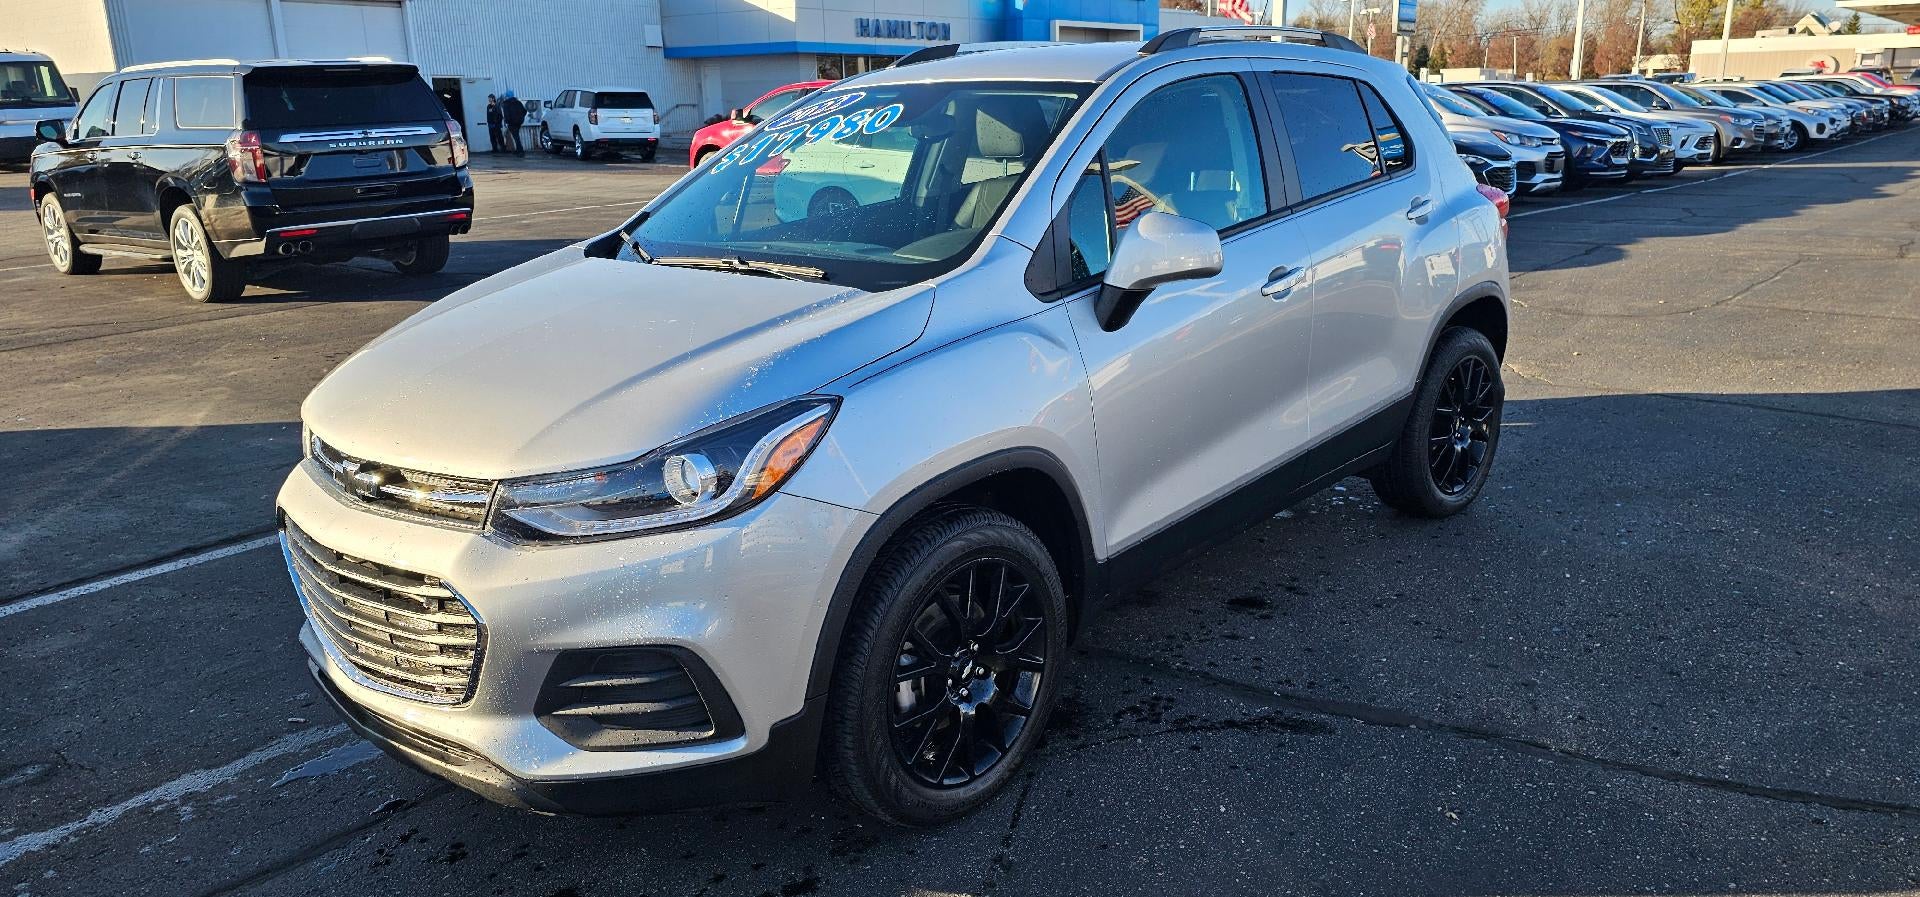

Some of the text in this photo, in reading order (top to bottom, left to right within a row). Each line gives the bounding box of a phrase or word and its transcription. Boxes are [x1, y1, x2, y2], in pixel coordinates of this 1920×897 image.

[855, 18, 951, 41] HAMILTON
[329, 138, 404, 148] SUBURBAN
[711, 104, 905, 174] $17980
